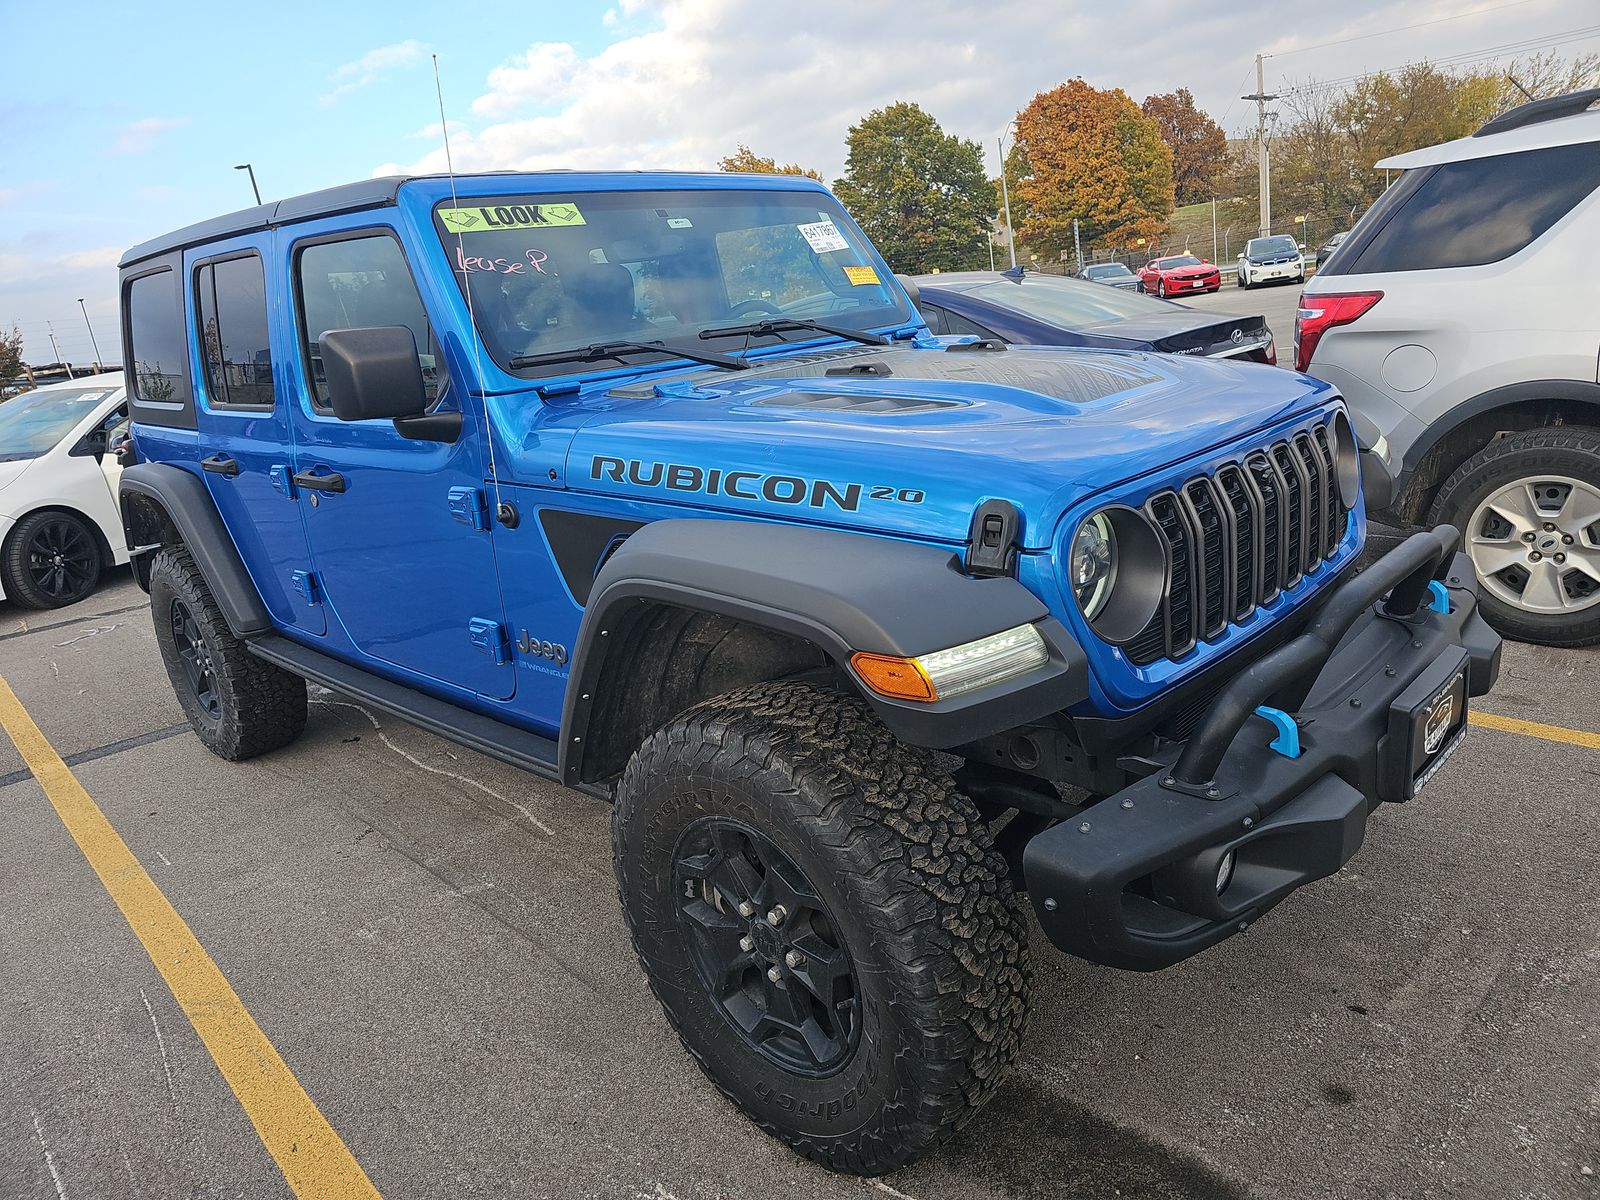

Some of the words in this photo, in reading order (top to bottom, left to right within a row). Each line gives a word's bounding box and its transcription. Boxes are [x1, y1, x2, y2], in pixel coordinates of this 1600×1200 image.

[479, 205, 549, 226] LOOK
[590, 454, 864, 513] RUBICON
[869, 485, 926, 504] 20
[516, 628, 568, 667] Jeep
[527, 663, 569, 680] WRANGLE
